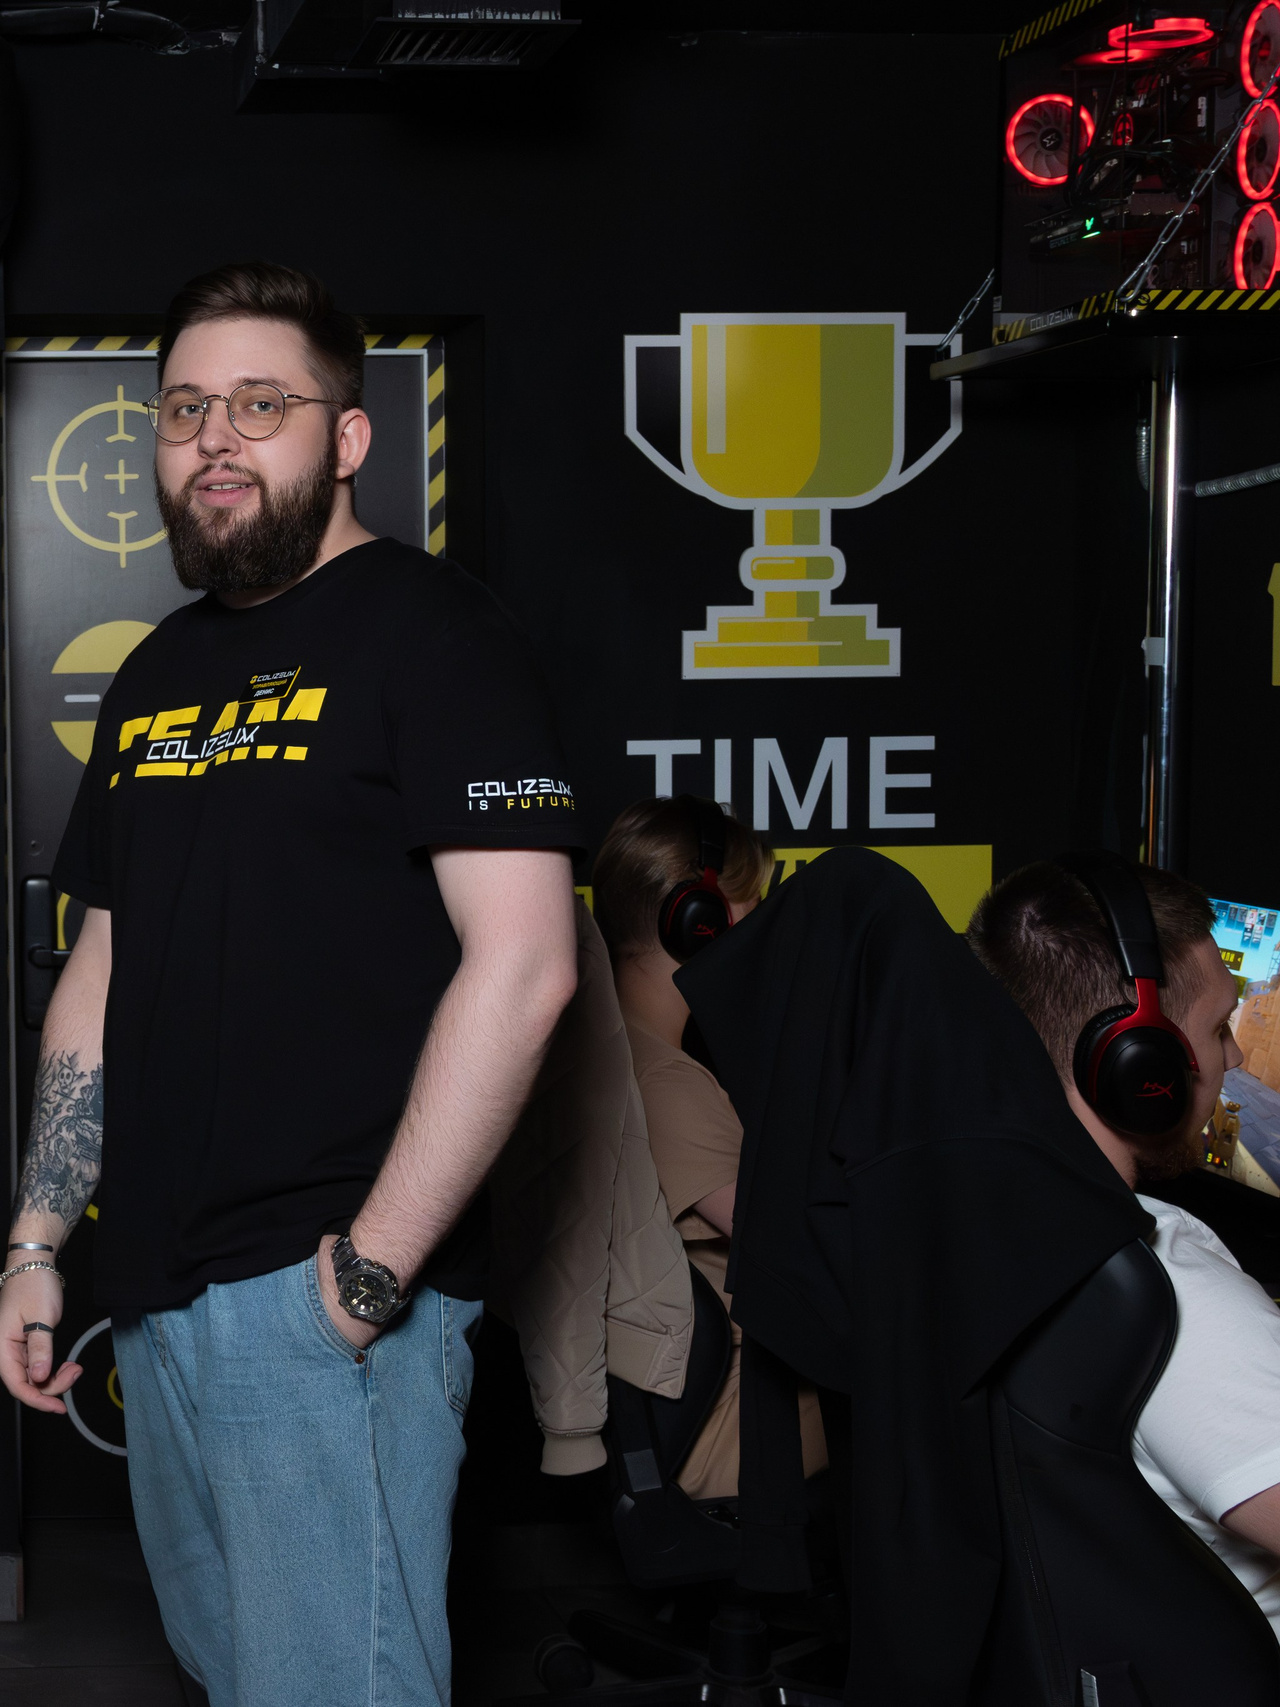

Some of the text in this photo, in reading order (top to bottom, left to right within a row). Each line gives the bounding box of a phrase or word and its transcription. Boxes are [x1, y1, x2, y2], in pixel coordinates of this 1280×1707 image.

[146, 725, 260, 760] COLIZEUM
[626, 735, 936, 831] TIME
[468, 800, 489, 811] IS
